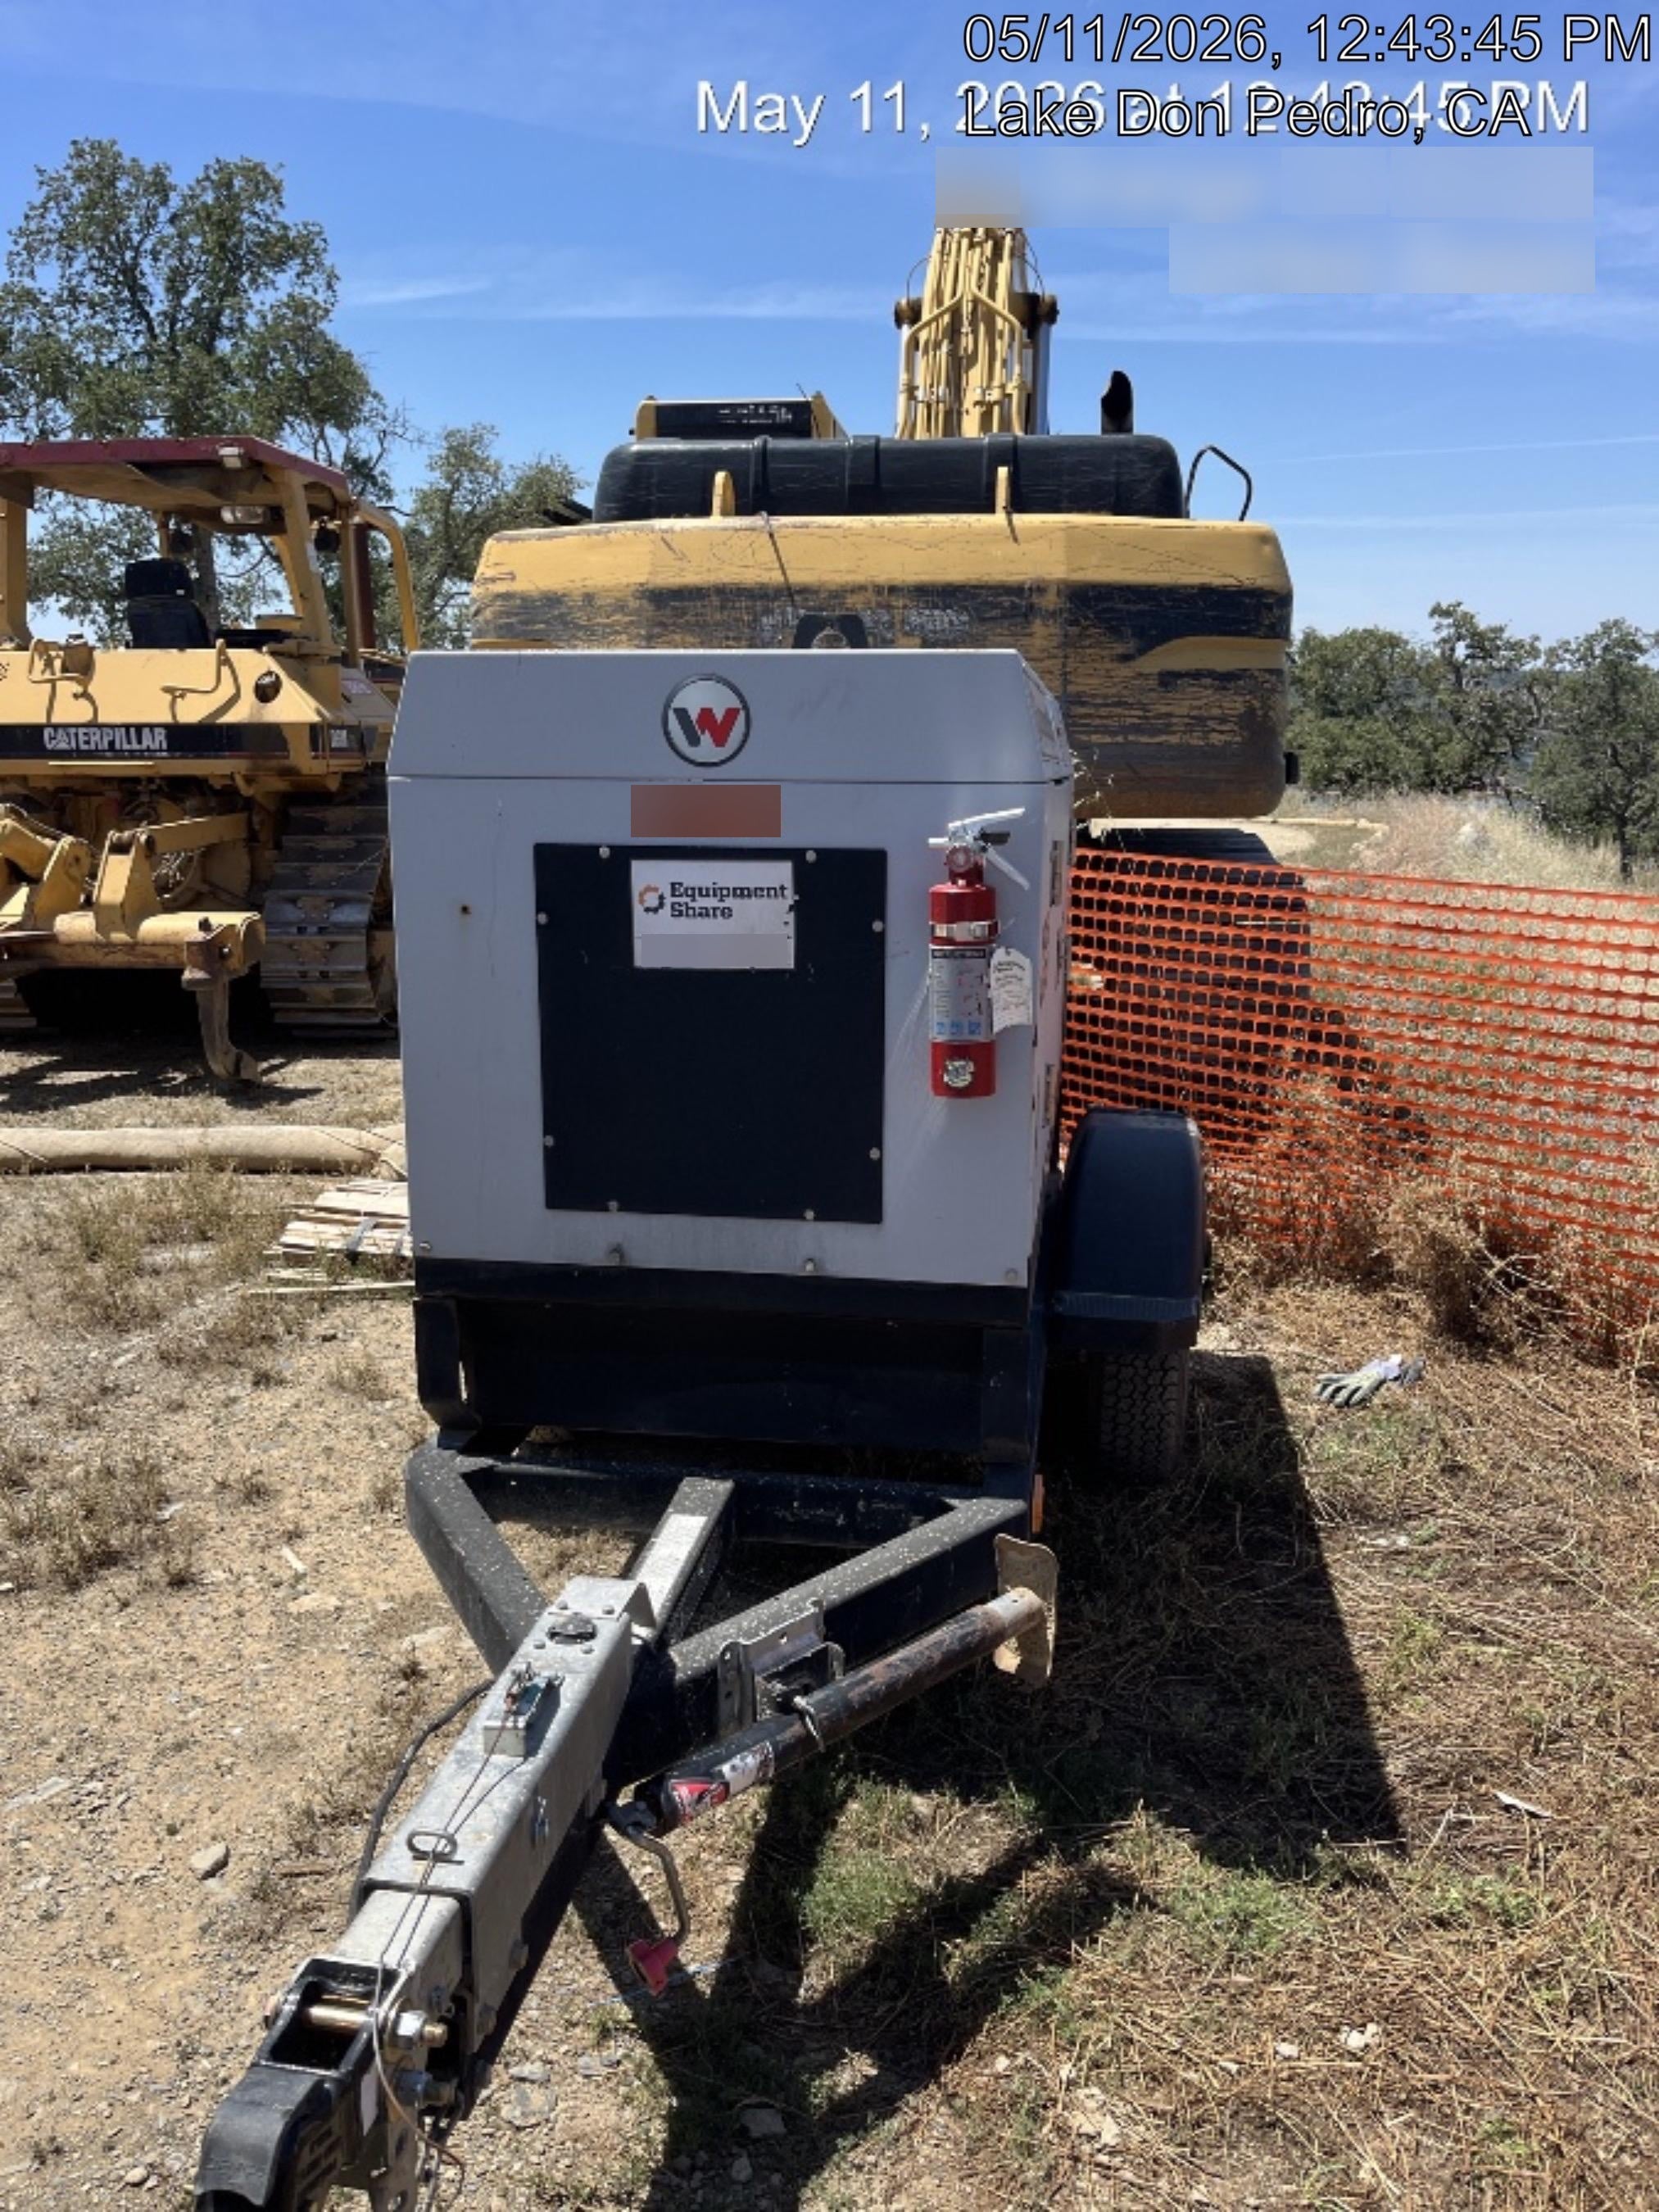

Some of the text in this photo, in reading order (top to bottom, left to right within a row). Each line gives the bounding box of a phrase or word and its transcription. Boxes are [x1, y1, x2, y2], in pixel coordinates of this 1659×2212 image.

[43, 727, 168, 750] CATERPILLAR
[670, 882, 788, 903] Equipment
[670, 902, 734, 919] Share
